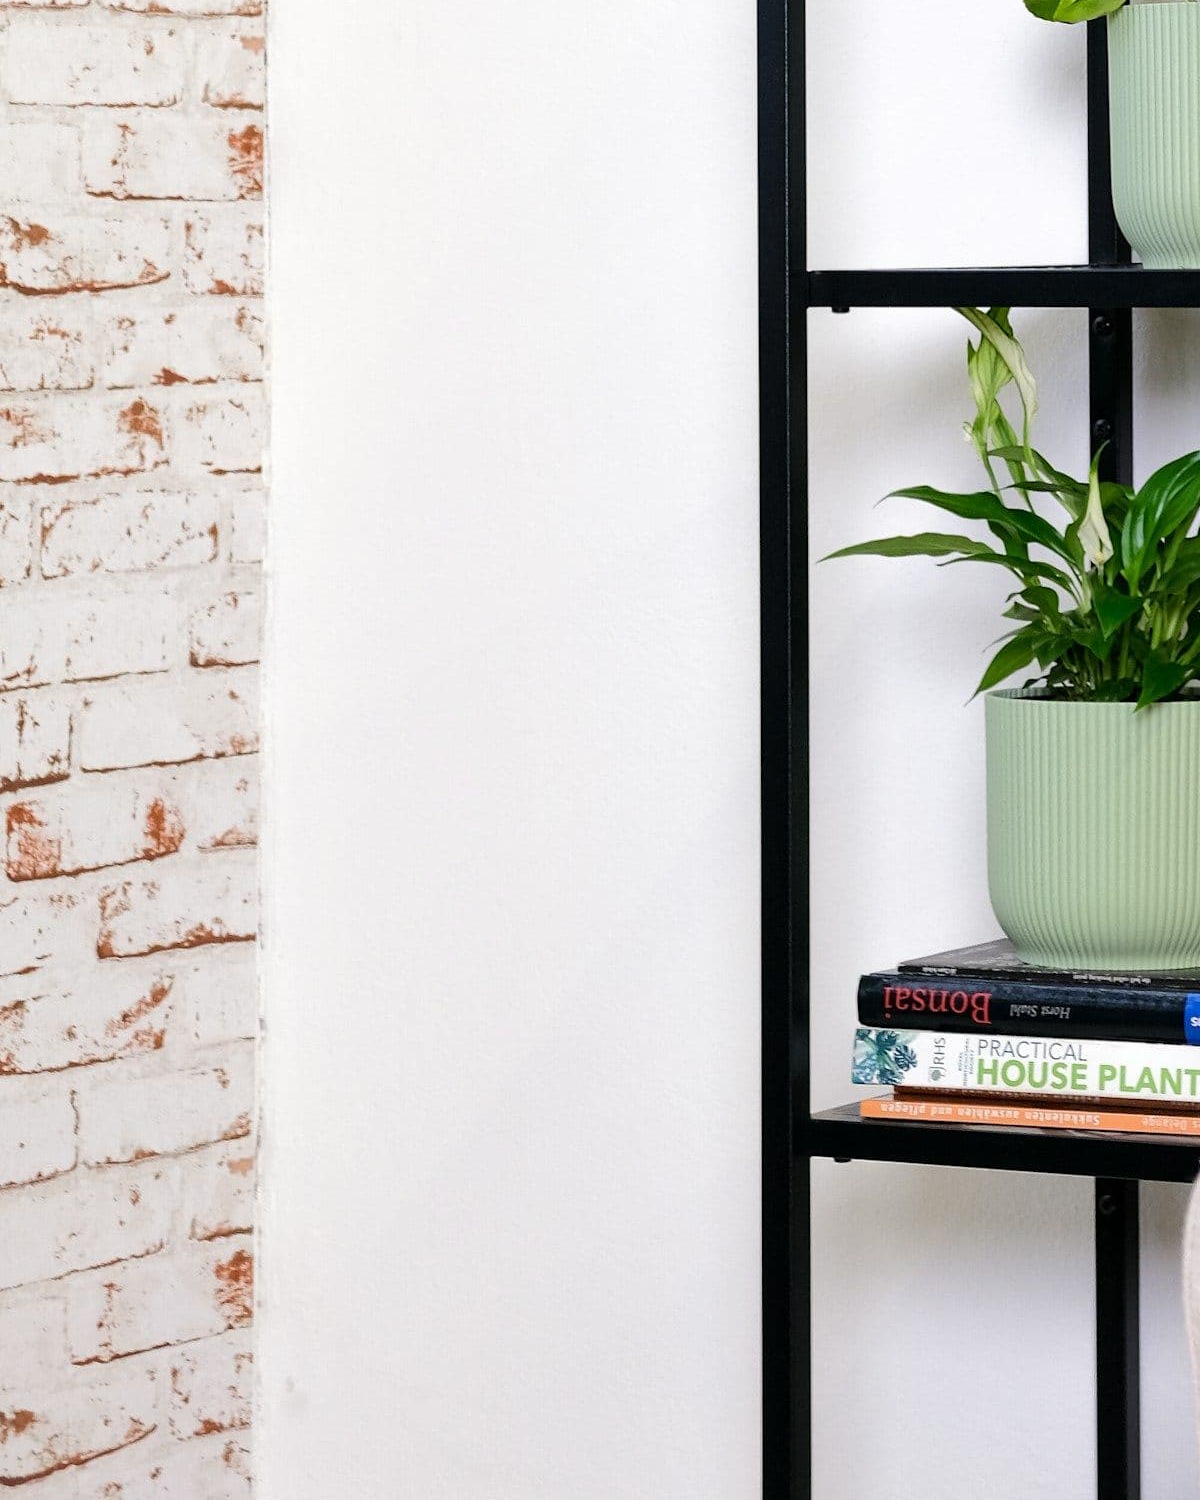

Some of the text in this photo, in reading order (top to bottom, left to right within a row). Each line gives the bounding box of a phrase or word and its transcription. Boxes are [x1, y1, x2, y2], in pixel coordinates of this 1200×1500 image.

[883, 986, 992, 1025] Bonsai
[1009, 1004, 1038, 1017] Stahl
[1040, 1005, 1071, 1019] Horst
[932, 1037, 946, 1065] RHS
[977, 1039, 1088, 1062] PRACTICAL
[976, 1058, 1088, 1091] HOUSE
[880, 1103, 926, 1117] pflegen
[930, 1105, 952, 1117] und
[1025, 1111, 1100, 1126] Sukkulenten
